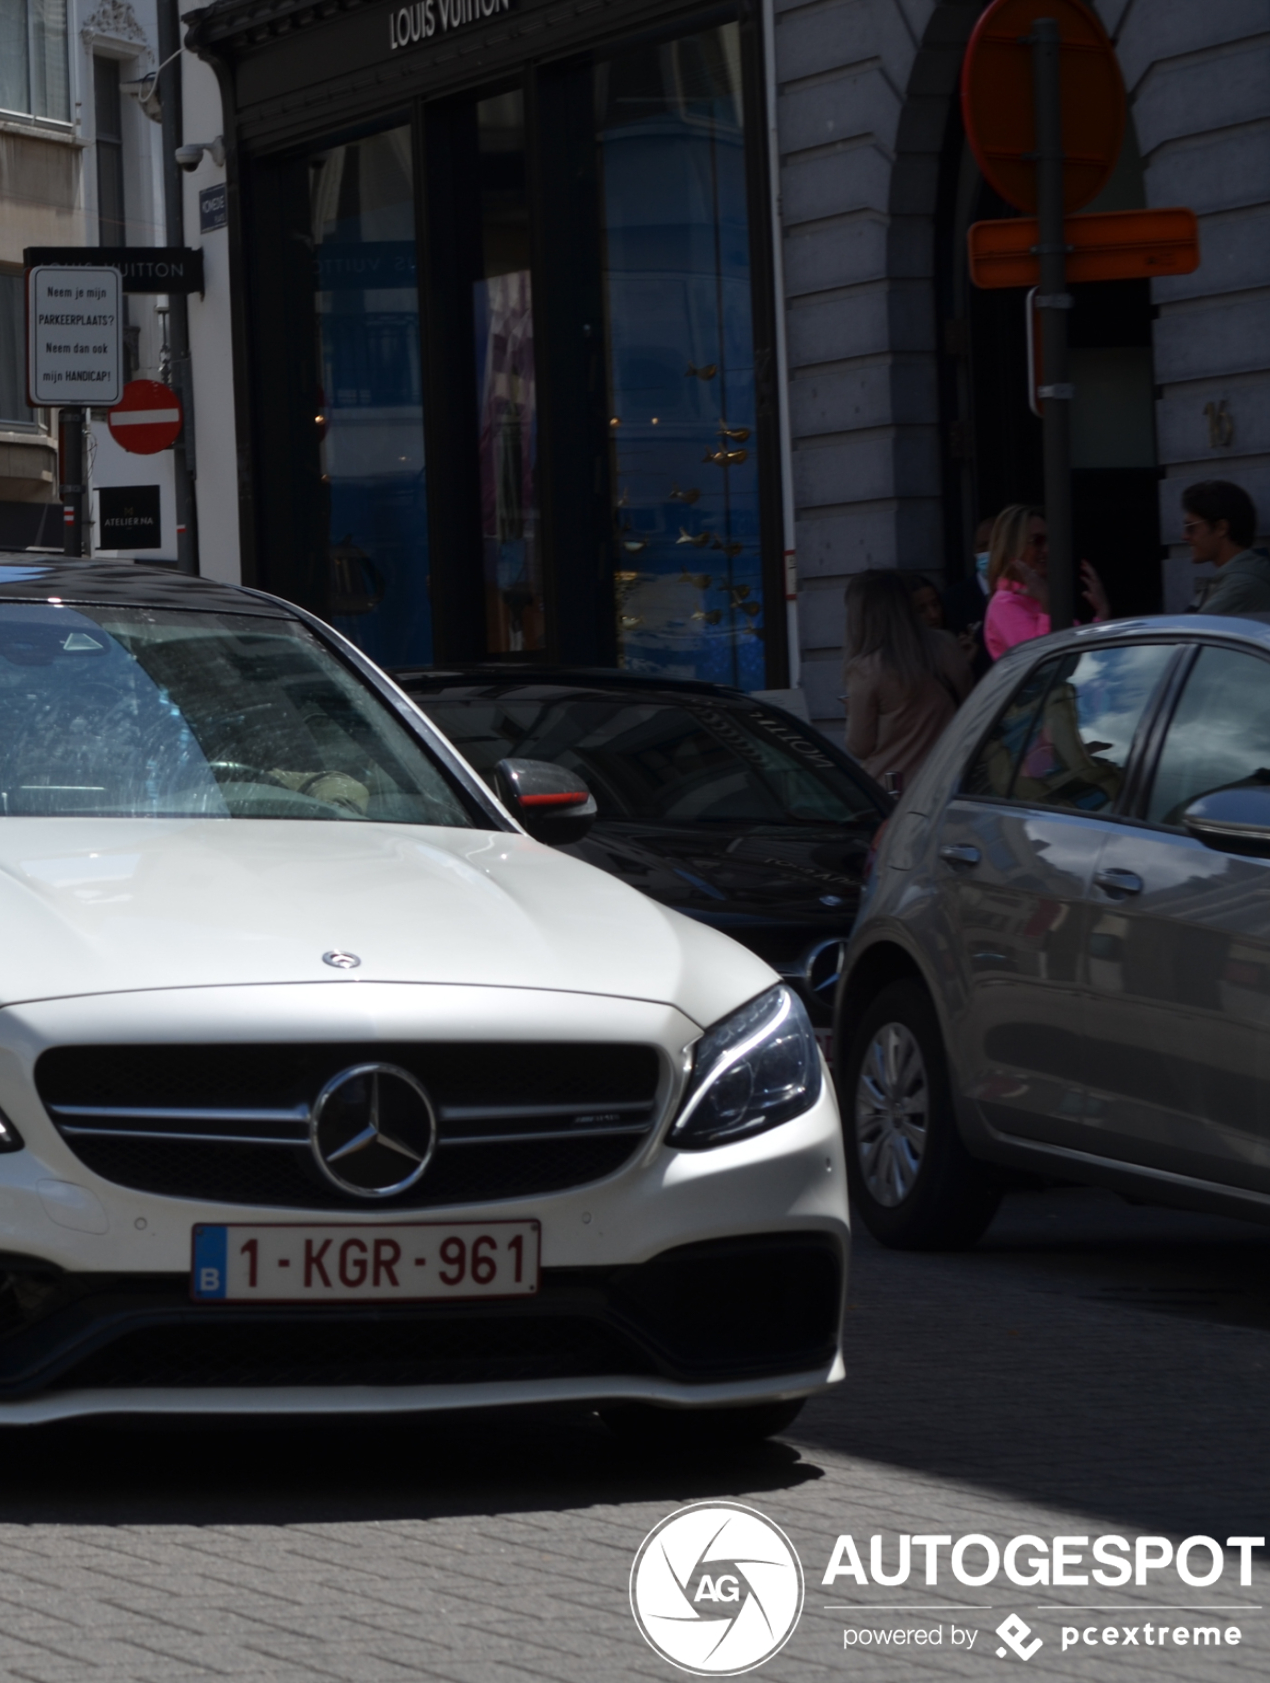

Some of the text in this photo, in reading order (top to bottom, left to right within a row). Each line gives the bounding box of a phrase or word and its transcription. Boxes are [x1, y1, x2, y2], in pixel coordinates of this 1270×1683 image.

[390, 0, 435, 49] LOUIS
[106, 262, 184, 277] UITTON
[47, 286, 107, 300] Neem je mijn
[39, 314, 114, 326] PARKEERPLAATS?
[46, 342, 108, 354] Neem dan ook
[43, 370, 111, 384] mijn HANDICAP!
[1203, 400, 1234, 448] 16
[240, 1235, 524, 1288] 1-KGR-961
[200, 1268, 220, 1291] B
